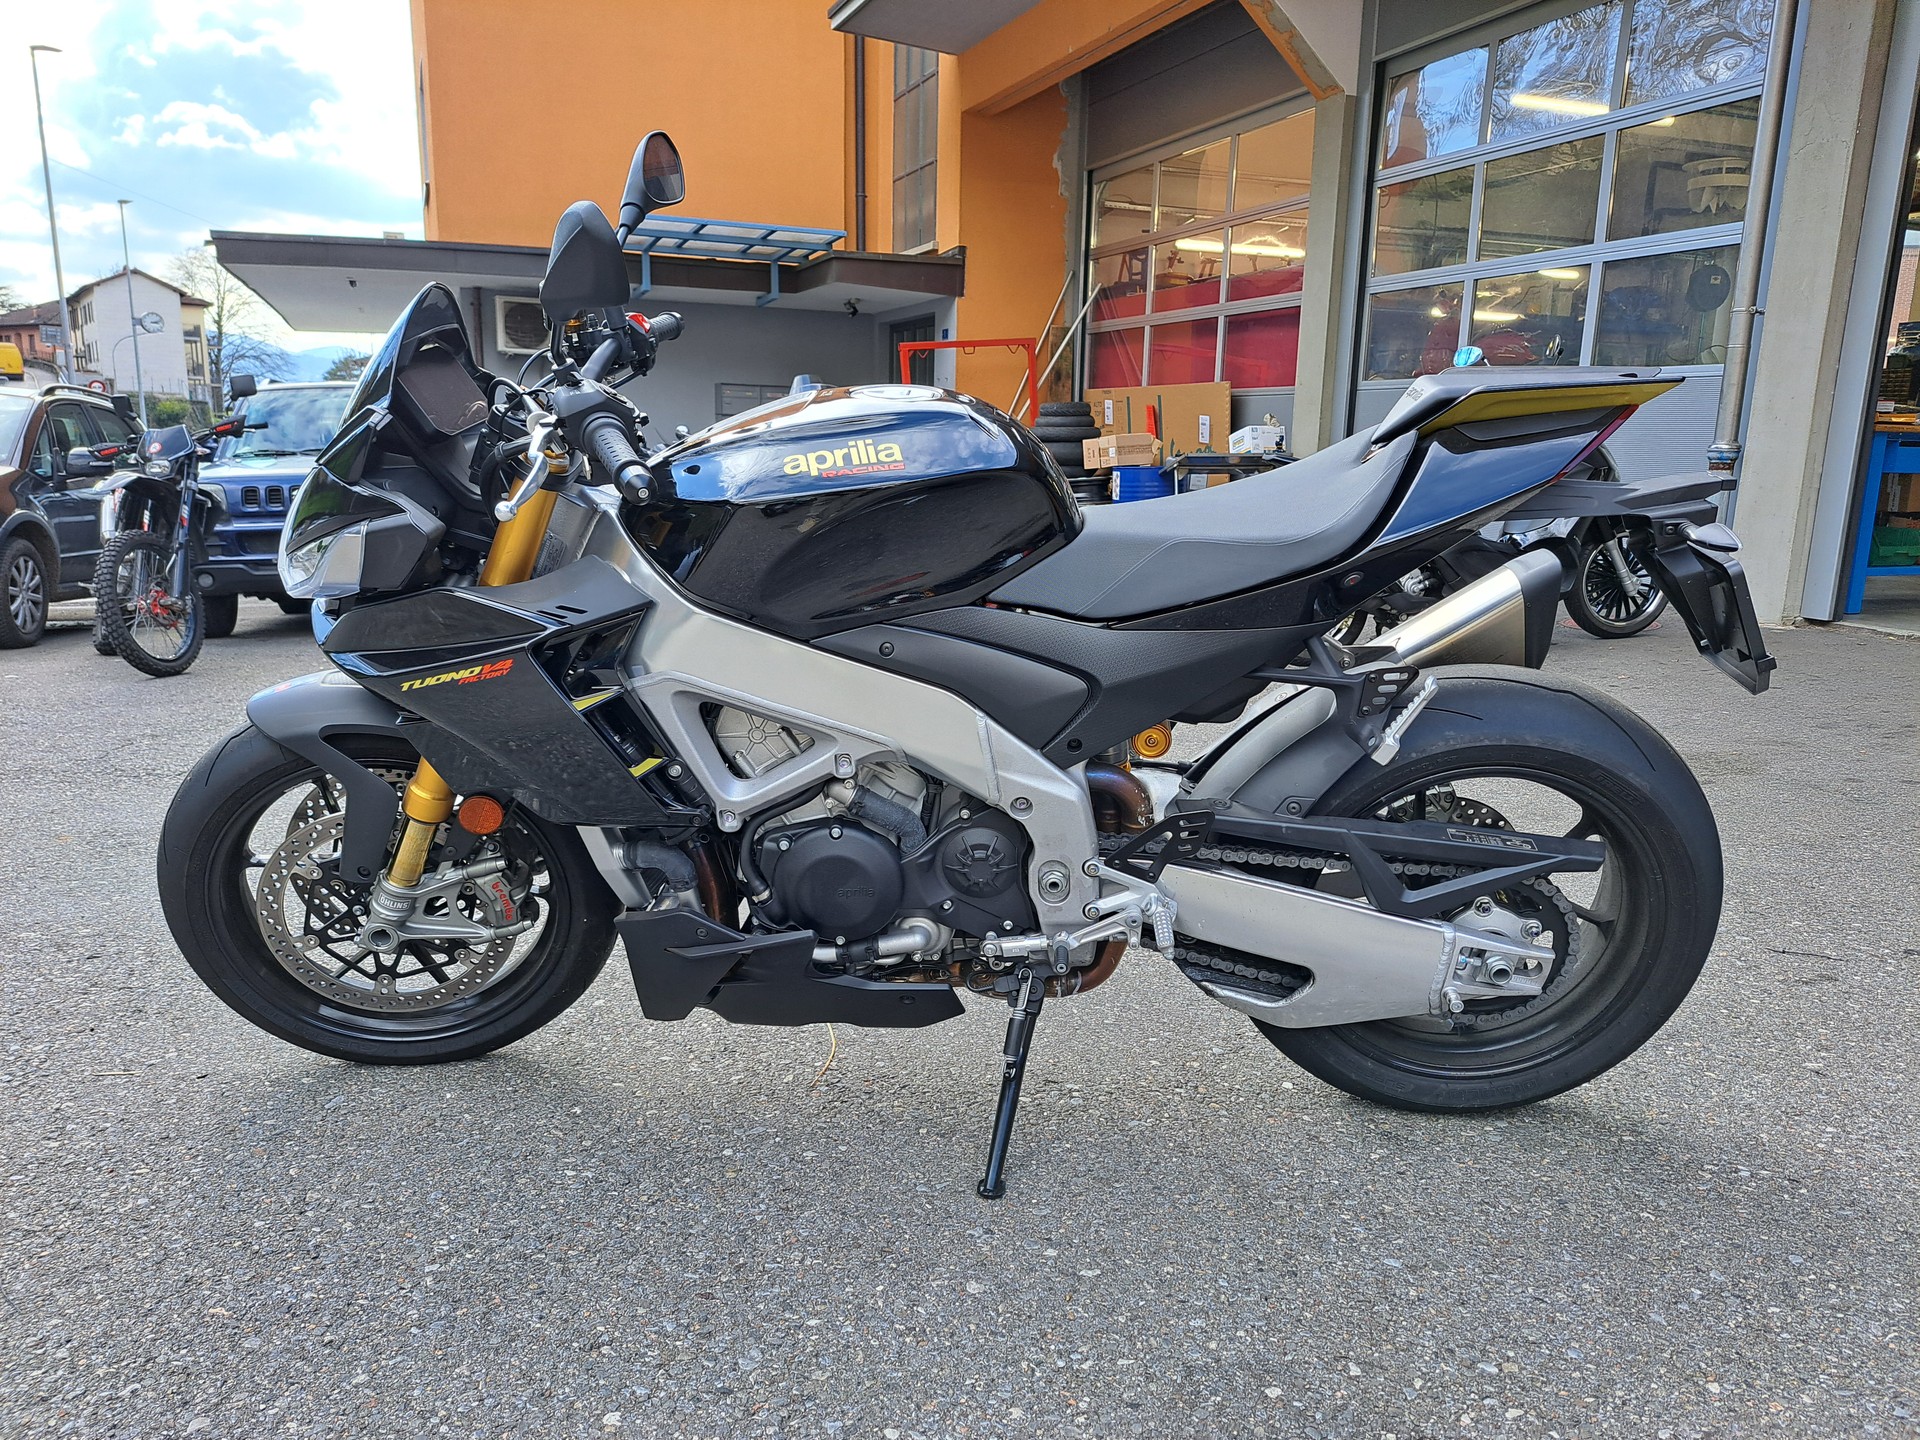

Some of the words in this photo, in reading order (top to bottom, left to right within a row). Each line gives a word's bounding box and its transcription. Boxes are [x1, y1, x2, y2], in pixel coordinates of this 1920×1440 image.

[783, 439, 904, 477] aprilia
[821, 462, 906, 478] RACING
[458, 668, 511, 686] FACTORY
[491, 881, 513, 921] brembo
